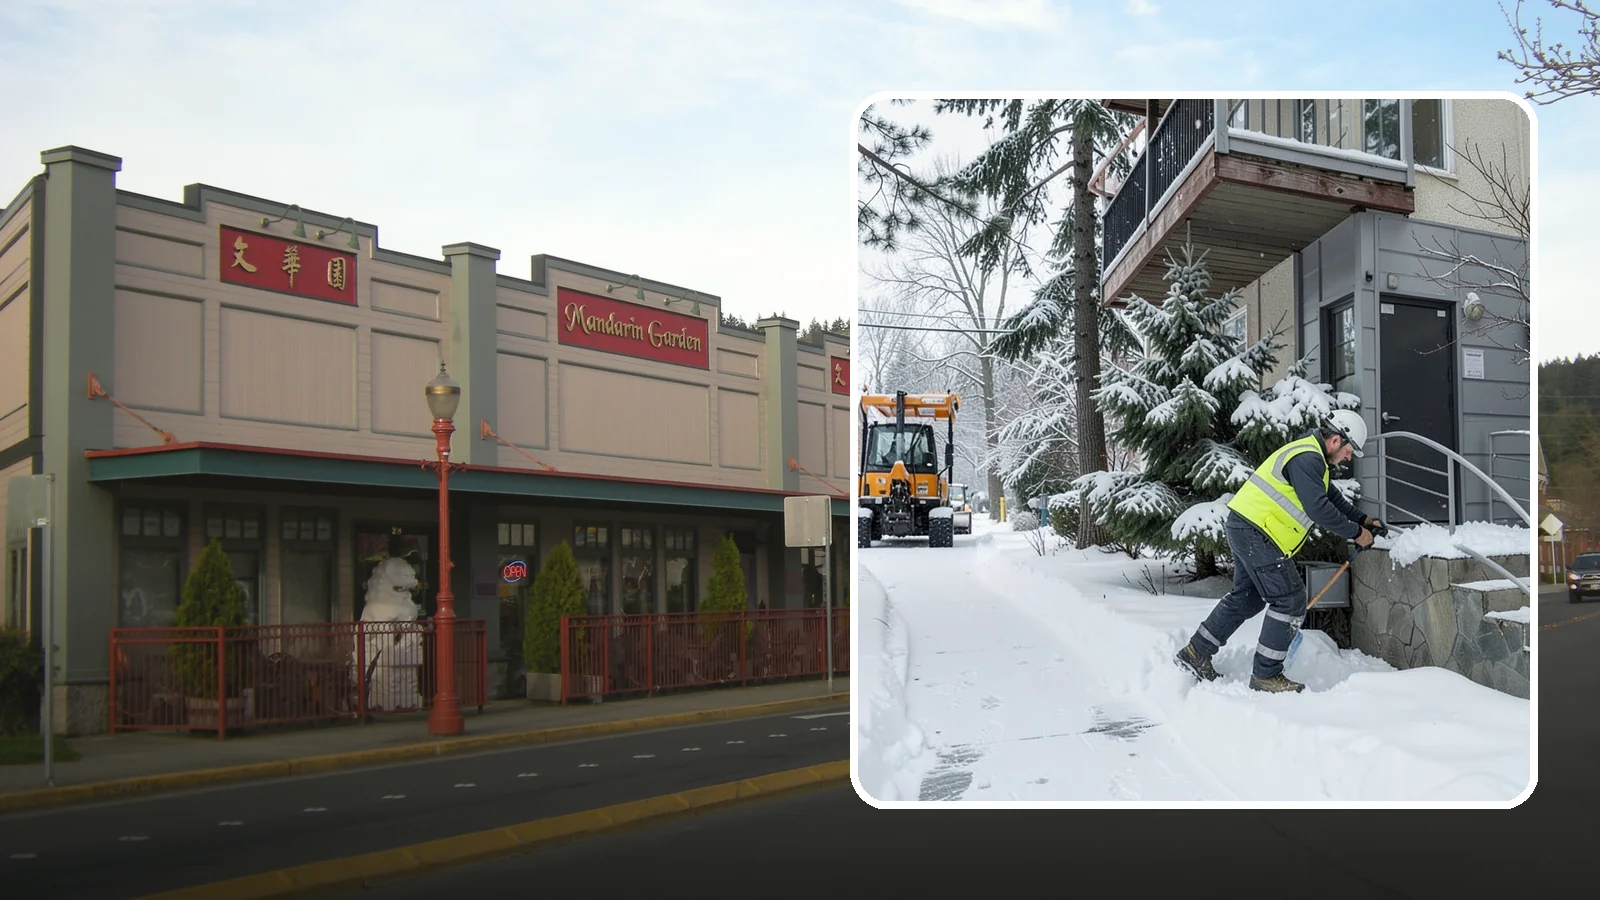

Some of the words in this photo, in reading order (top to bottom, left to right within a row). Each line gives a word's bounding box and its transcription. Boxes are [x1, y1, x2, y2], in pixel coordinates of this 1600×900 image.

[231, 236, 346, 290] 文華園
[564, 302, 644, 341] Mandarin
[648, 320, 701, 352] Garden
[503, 565, 527, 578] OPEN
